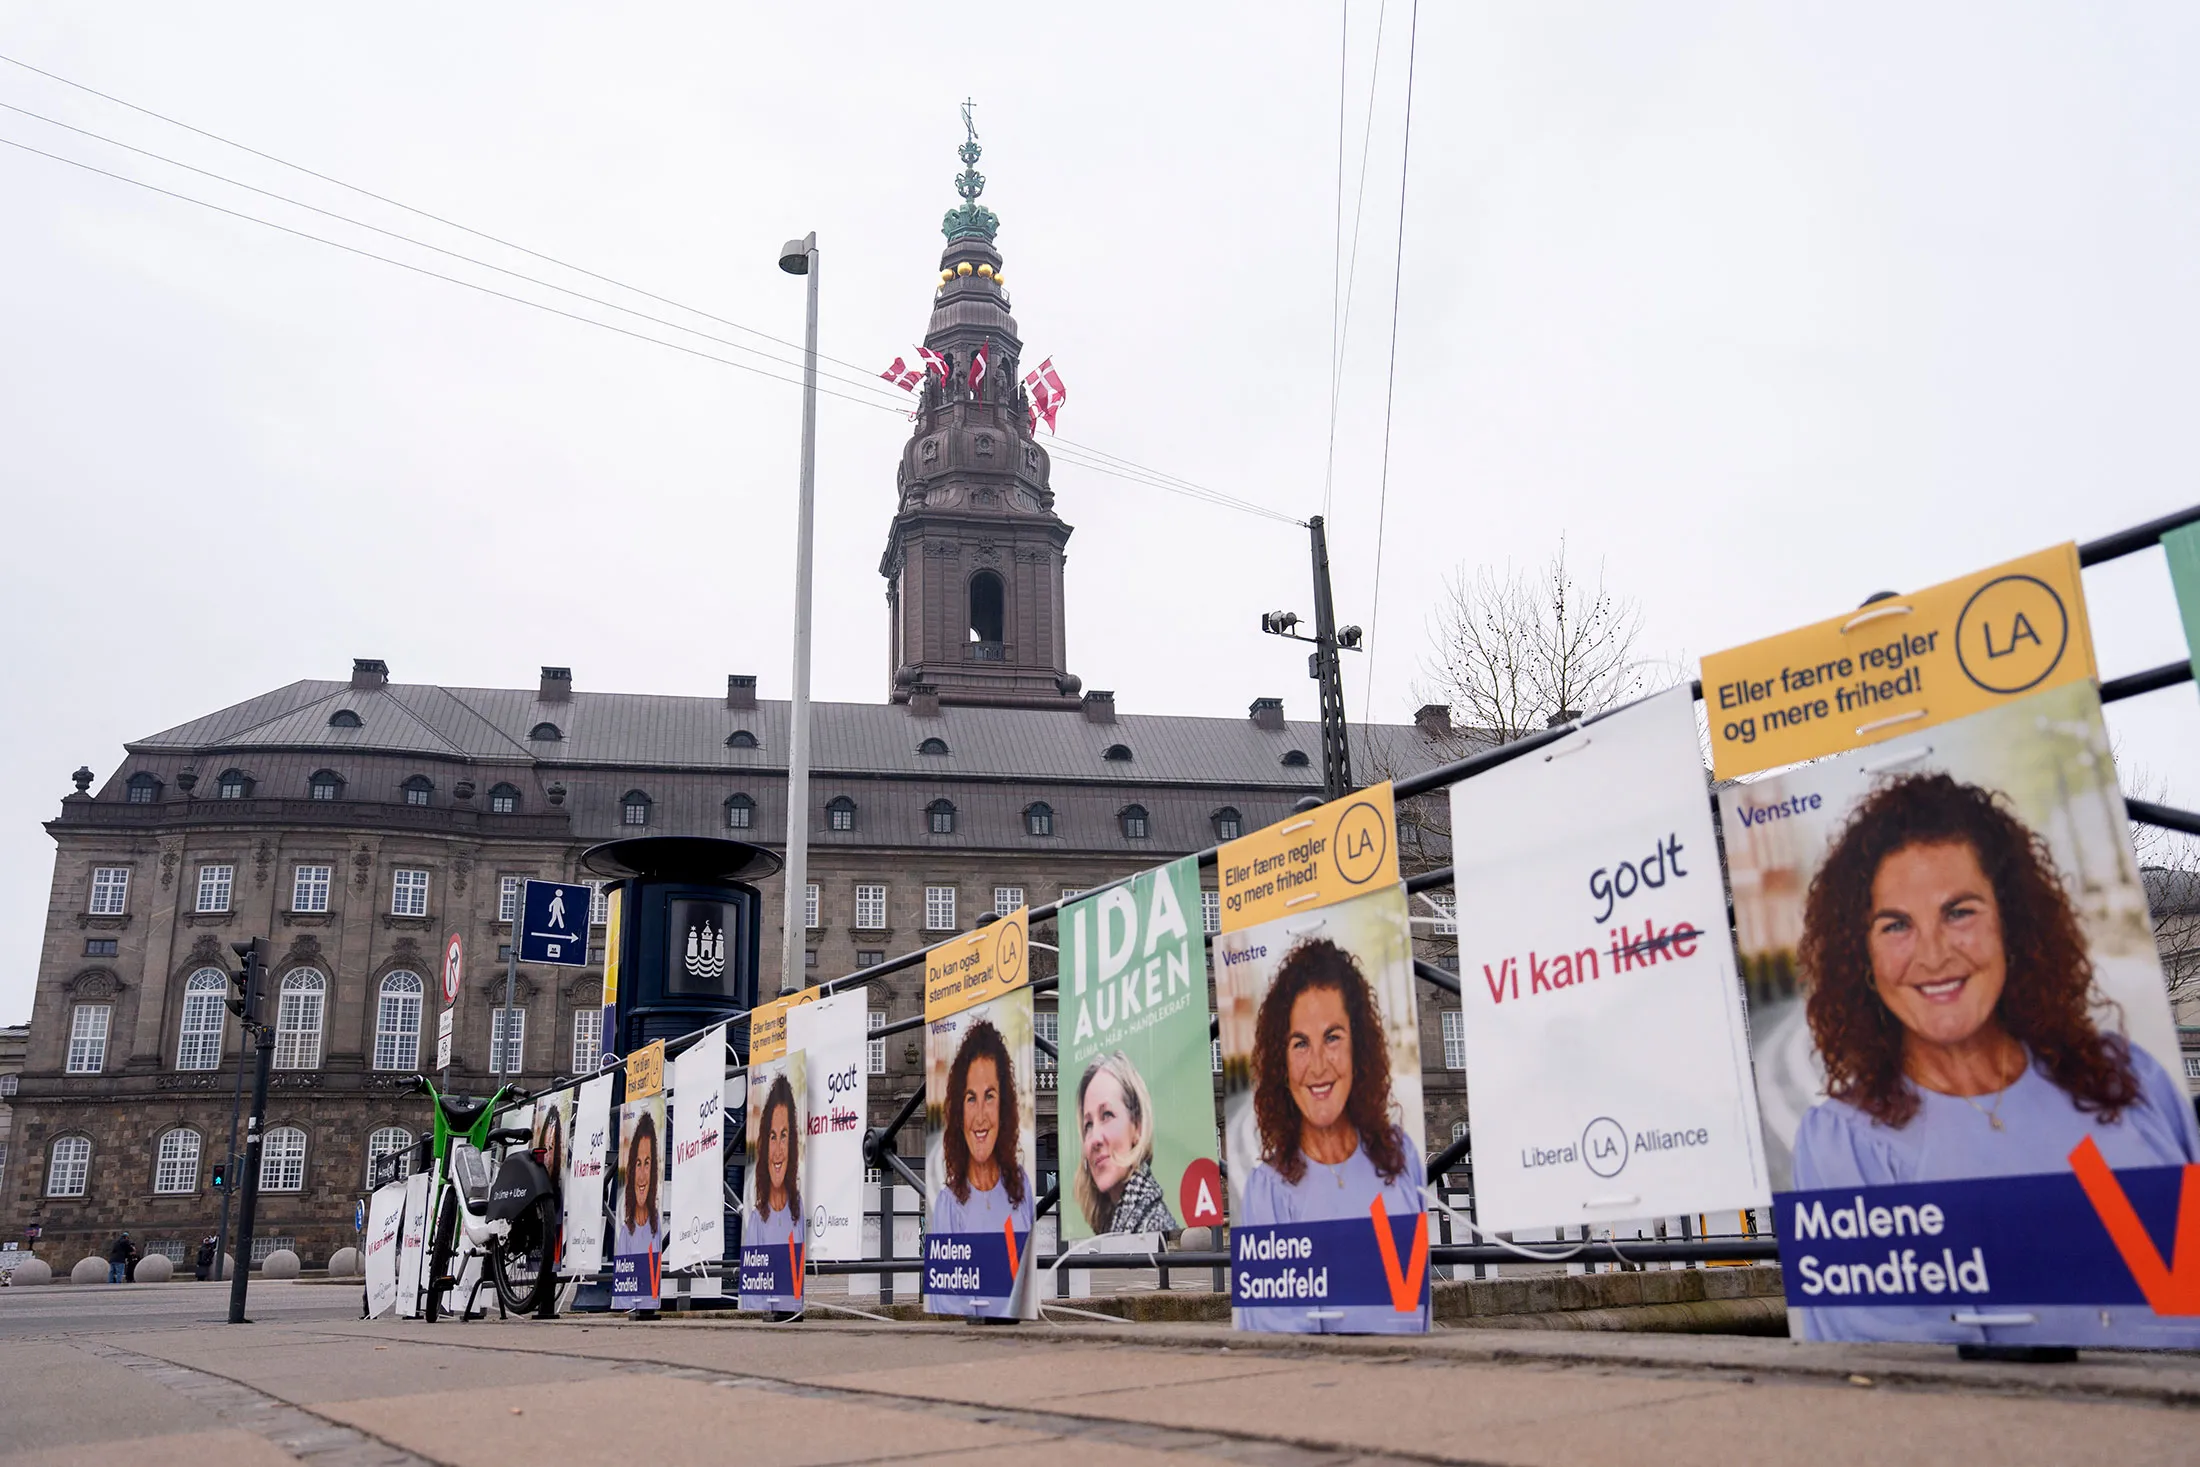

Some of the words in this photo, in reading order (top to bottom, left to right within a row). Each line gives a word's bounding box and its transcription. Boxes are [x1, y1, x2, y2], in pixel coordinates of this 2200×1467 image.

[1984, 611, 2042, 660] LA
[1718, 676, 1788, 711] Eller
[1780, 656, 1854, 695] færre
[1858, 629, 1939, 676] regler
[1723, 716, 1757, 744] og
[1762, 699, 1830, 733] mere
[1837, 666, 1923, 715] frihed!
[1737, 791, 1823, 830] Venstre
[1225, 865, 1252, 887] Eller
[1253, 854, 1286, 876] færre
[1288, 837, 1327, 868] regler
[1347, 828, 1375, 860] LA
[1226, 893, 1242, 912] og
[1244, 884, 1275, 904] mere
[1276, 861, 1318, 892] frihed!
[1589, 832, 1688, 924] godt
[1074, 867, 1189, 997] IDA
[929, 967, 942, 983] Du
[943, 961, 959, 978] kan
[960, 948, 981, 971] også
[1003, 942, 1017, 964] LA
[1222, 944, 1268, 967] Venstre
[1483, 955, 1520, 1005] Vi
[1529, 945, 1600, 997] kan
[1608, 918, 1700, 975] ikke
[929, 982, 963, 1003] stemme
[1073, 939, 1191, 1046] AUKEN
[930, 1020, 957, 1036] Venstre
[1074, 1042, 1099, 1063] KLIMA
[1129, 993, 1191, 1035] HANDLEKRAFT
[828, 1063, 857, 1103] godt
[700, 1090, 718, 1129] godt
[807, 1112, 828, 1135] kan
[830, 1106, 858, 1132] ikke
[676, 1144, 684, 1165] Vi
[685, 1139, 700, 1160] kan
[1521, 1141, 1580, 1170] Liberal
[1593, 1136, 1619, 1160] LA
[1634, 1125, 1710, 1154] Alliance
[513, 1188, 527, 1198] Uber
[1194, 1176, 1217, 1217] A
[827, 1215, 848, 1227] Alliance
[1795, 1196, 1945, 1240] Malene
[2067, 1133, 2200, 1317] V
[743, 1249, 769, 1267] Malene
[930, 1238, 972, 1260] Malene
[1239, 1230, 1312, 1261] Malene
[1369, 1192, 1429, 1313] V
[614, 1276, 638, 1292] Sandfeld
[615, 1258, 635, 1273] Malene
[648, 1241, 662, 1299] V
[742, 1272, 775, 1291] Sandfeld
[788, 1231, 805, 1300] V
[929, 1266, 980, 1290] Sandfeld
[1239, 1266, 1328, 1299] Sandfeld
[1799, 1246, 1990, 1296] Sandfeld
